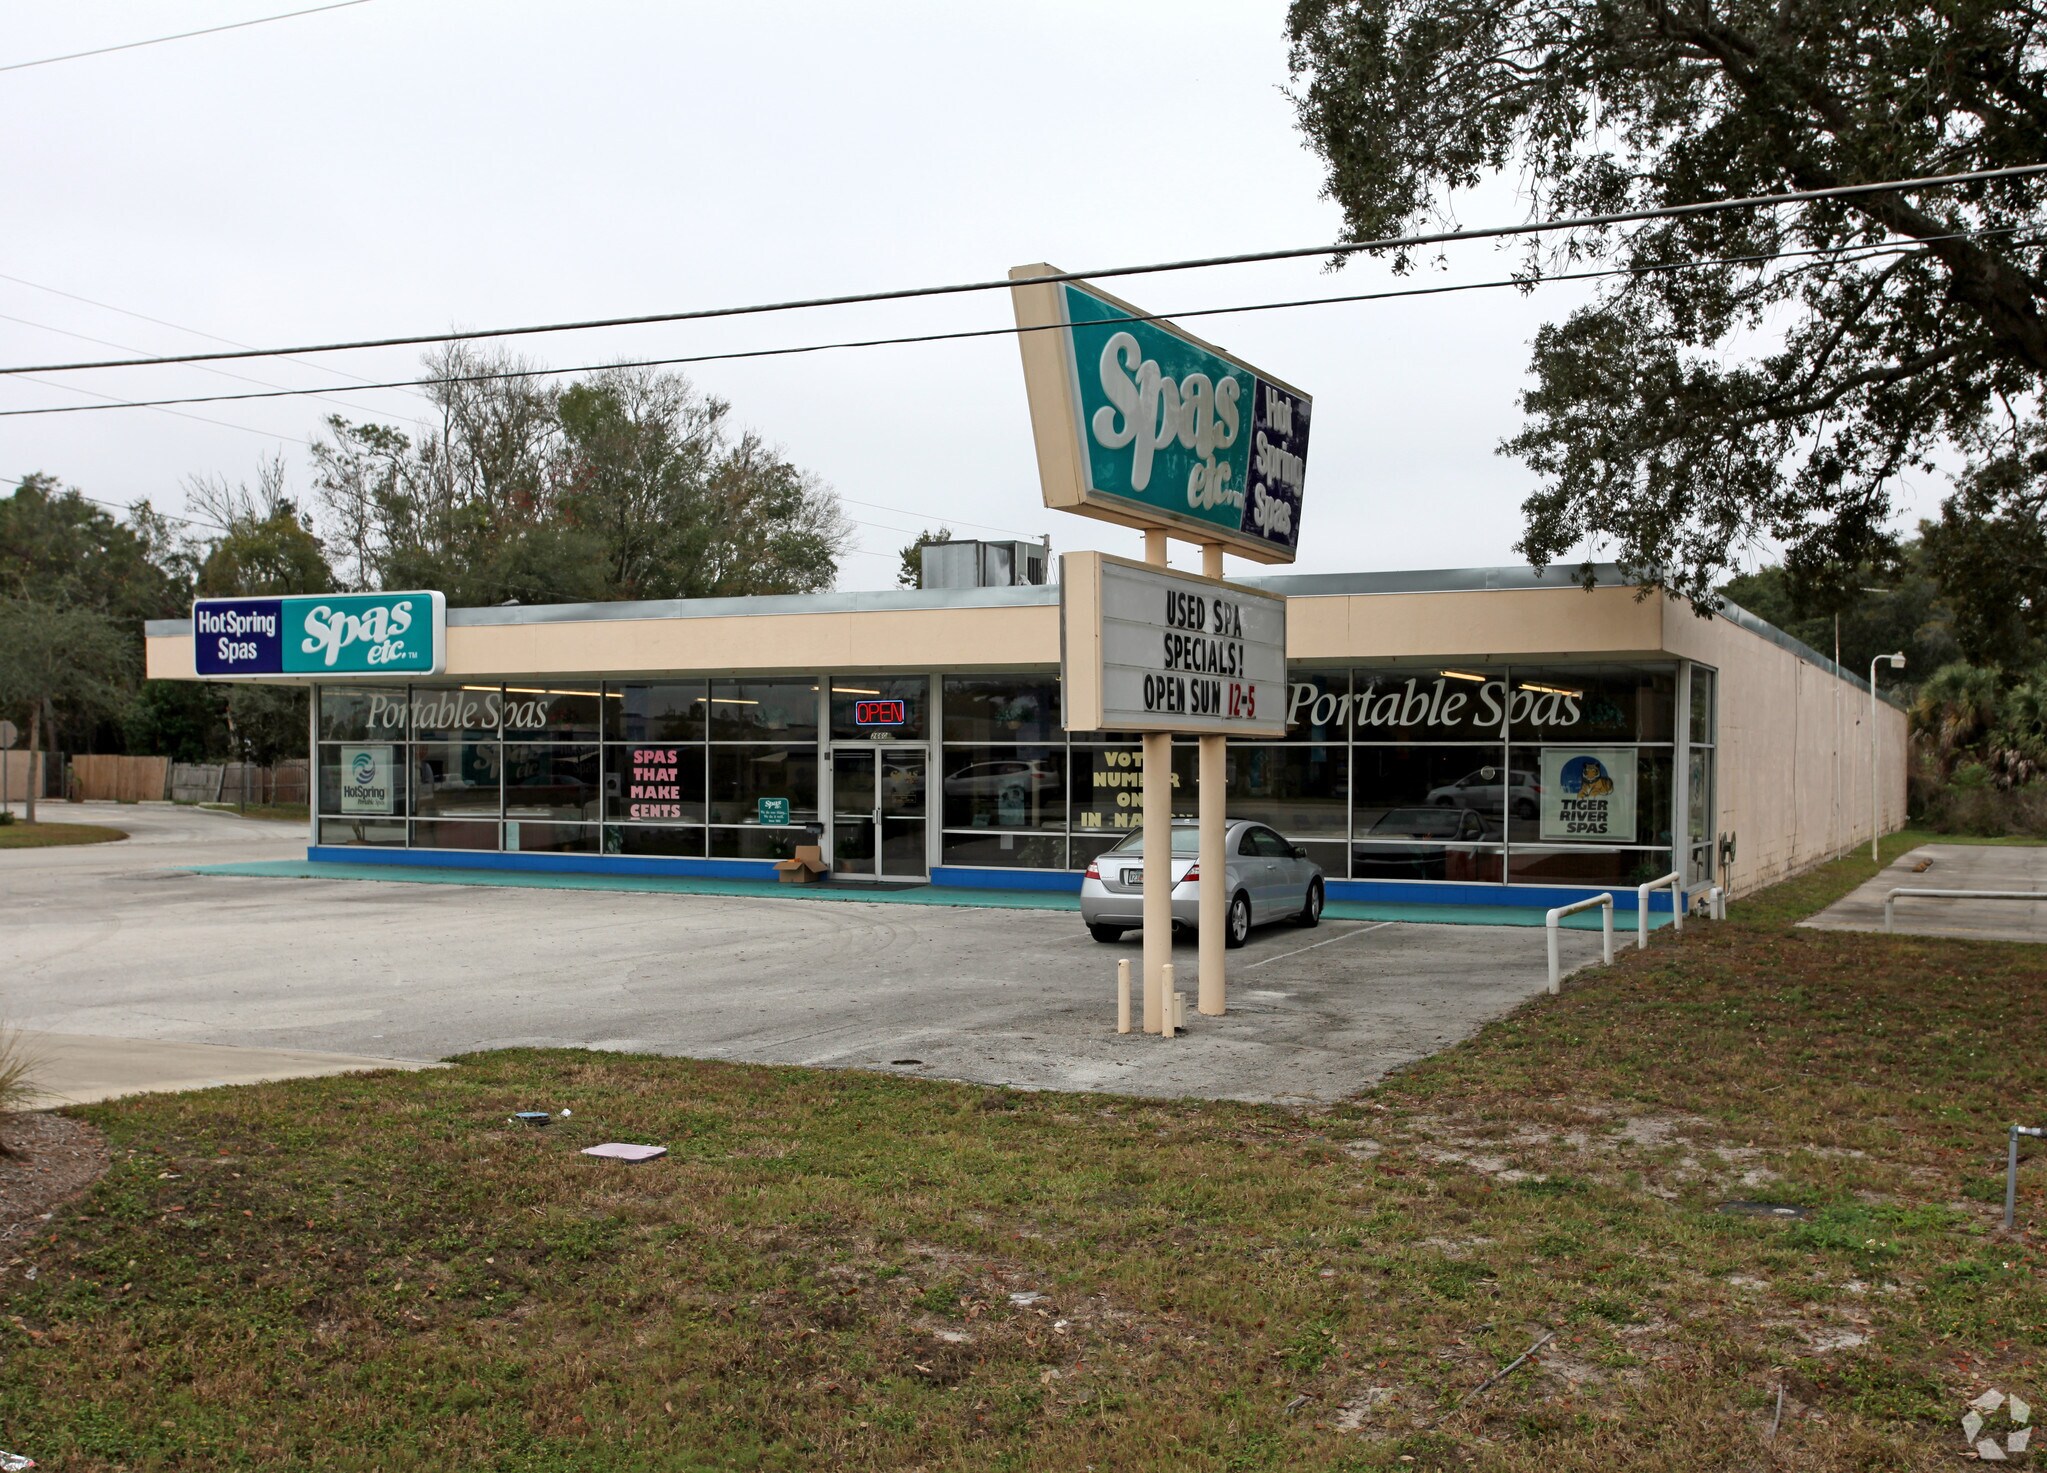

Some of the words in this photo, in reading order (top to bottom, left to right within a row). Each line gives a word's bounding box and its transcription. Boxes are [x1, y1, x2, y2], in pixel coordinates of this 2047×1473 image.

[1092, 331, 1240, 491] Spas
[1265, 386, 1292, 437] Hot
[1256, 430, 1303, 497] Spring
[1254, 482, 1291, 538] Spas
[199, 610, 275, 637] HotSpring
[1166, 590, 1205, 628] USED
[1213, 600, 1242, 636] SPA
[302, 601, 412, 666] Spas
[218, 637, 257, 663] Spas
[367, 640, 406, 665] etc.
[1164, 632, 1243, 675] SPECIALS!
[1144, 674, 1185, 712] OPEN
[1191, 679, 1221, 714] SUN
[1228, 683, 1255, 717] 12-5
[365, 691, 478, 729] Portable
[481, 694, 549, 739] Spas
[857, 702, 903, 722] OPEN
[1286, 678, 1467, 727] Portable
[1473, 680, 1583, 737] Spas
[633, 750, 678, 764] SPAS
[1104, 752, 1143, 767] VOT
[633, 767, 678, 781] THAT
[1093, 772, 1180, 787] NUMR
[344, 785, 385, 800] HotSpring
[630, 785, 680, 799] MAKE
[1116, 792, 1143, 807] ON
[630, 804, 681, 820] CENTS
[1561, 800, 1608, 810] TIGER
[1081, 812, 1101, 827] IN
[1560, 811, 1608, 822] RIVER
[1567, 822, 1608, 833] SPAS
